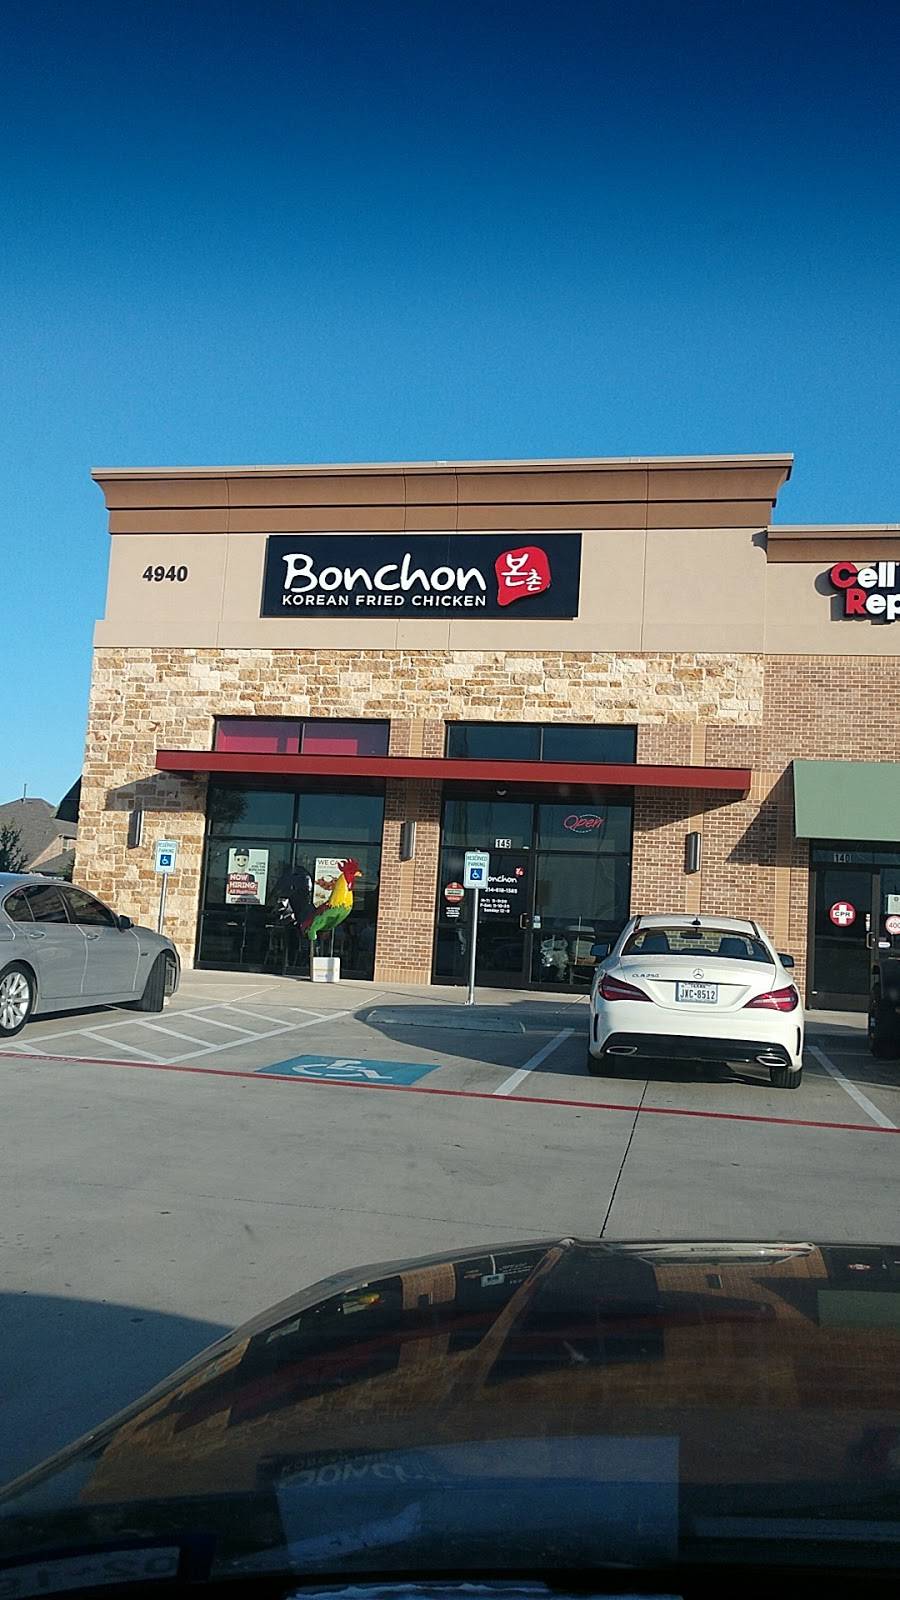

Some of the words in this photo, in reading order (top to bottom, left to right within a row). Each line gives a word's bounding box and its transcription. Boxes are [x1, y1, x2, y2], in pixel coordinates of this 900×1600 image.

[142, 565, 188, 582] 4940
[282, 553, 487, 593] Bonchon
[501, 553, 542, 591] 본촌
[831, 561, 895, 588] Cell
[282, 594, 349, 606] KOREAN
[355, 595, 405, 606] FRIED
[411, 595, 486, 607] CHICKEN
[563, 815, 604, 830] Open
[497, 838, 511, 848] 145
[230, 873, 249, 881] NOW
[487, 875, 518, 884] onchon
